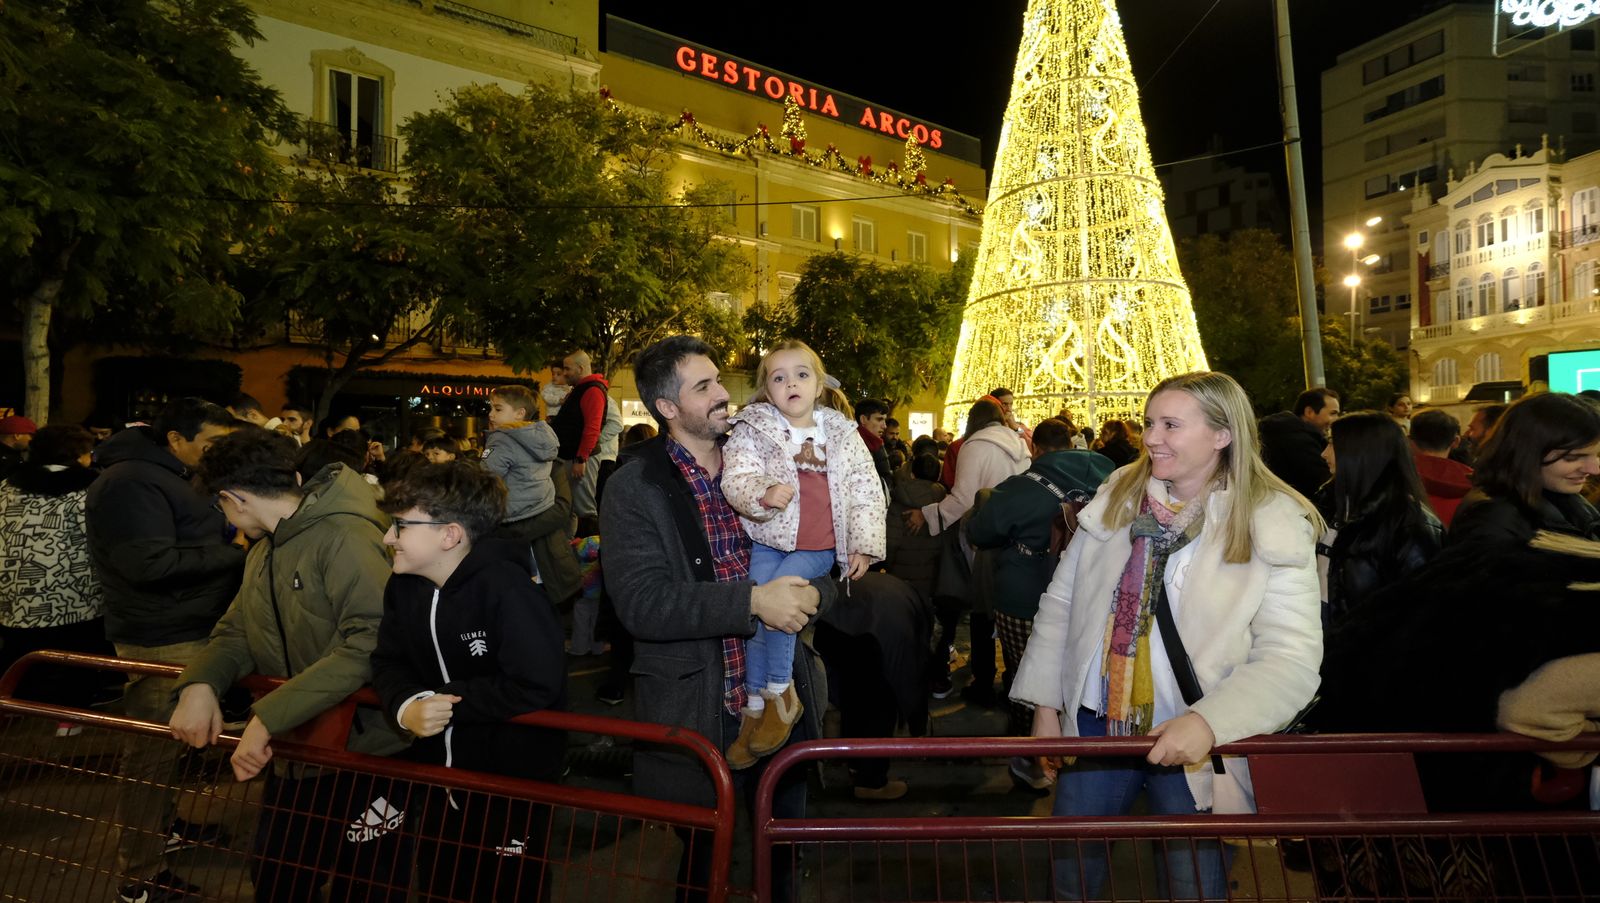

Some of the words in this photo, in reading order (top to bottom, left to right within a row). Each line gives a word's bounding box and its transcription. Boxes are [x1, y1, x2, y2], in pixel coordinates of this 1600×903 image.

[676, 46, 839, 117] GESTORIA
[860, 107, 942, 149] ARCOS
[346, 810, 405, 842] adidas
